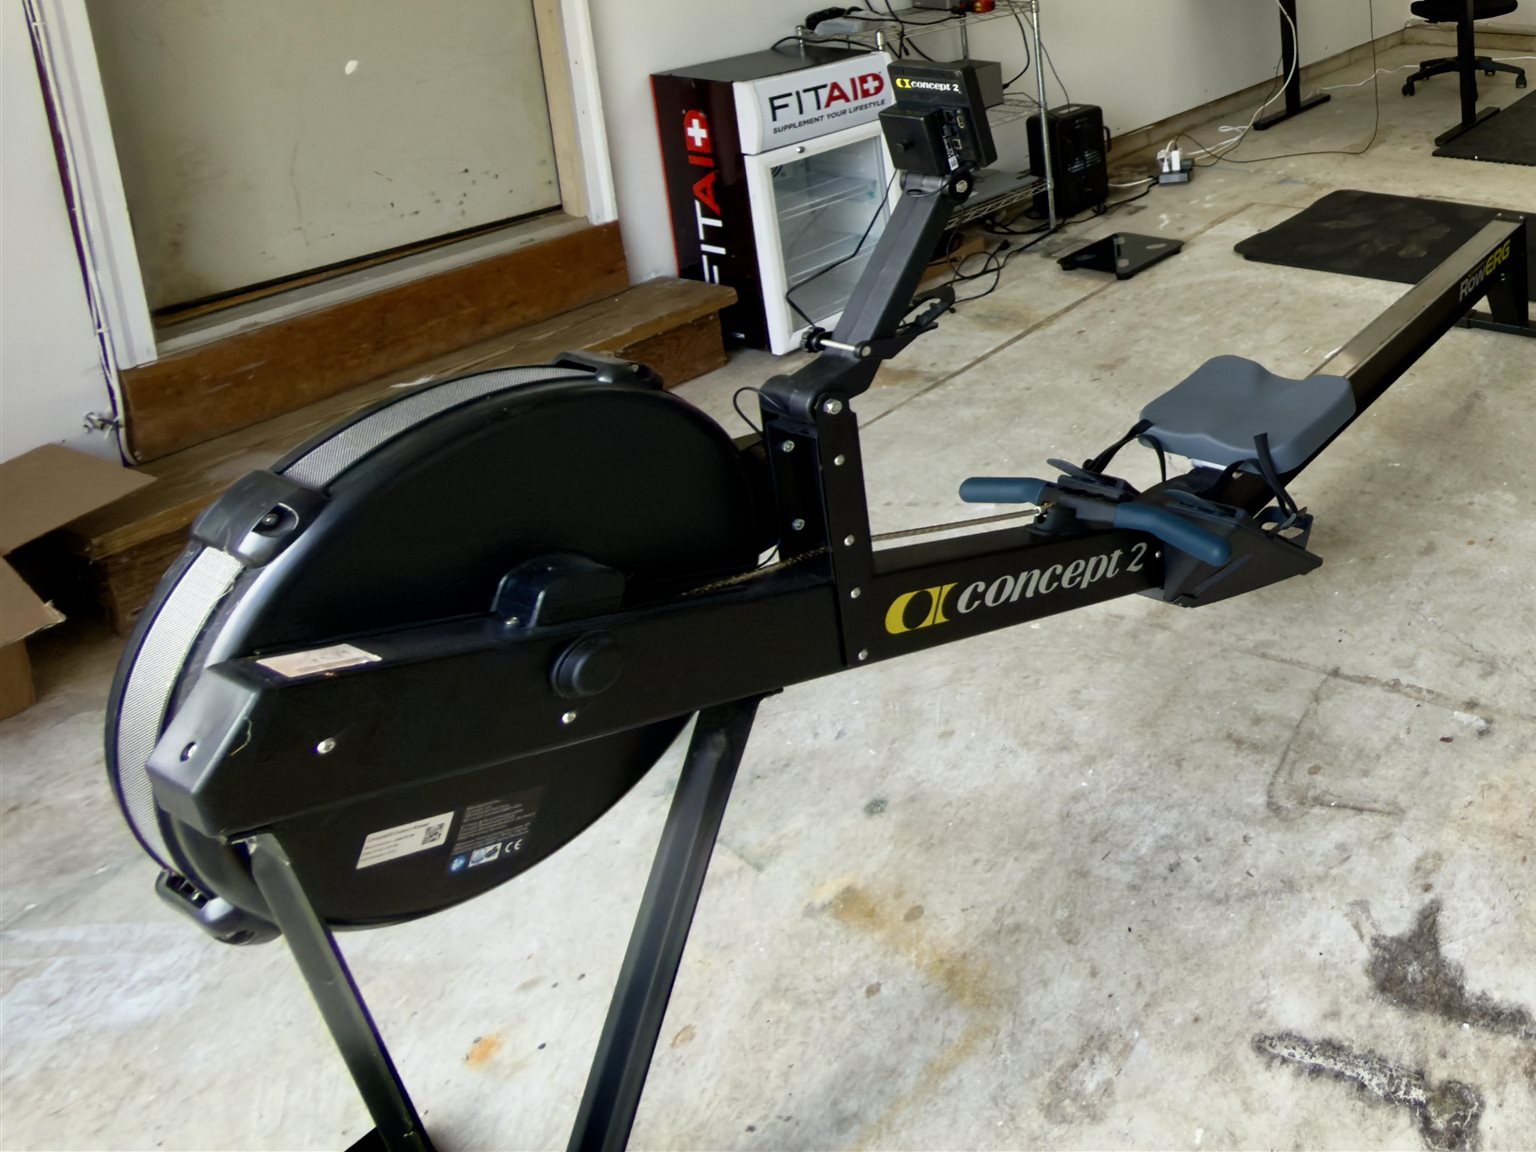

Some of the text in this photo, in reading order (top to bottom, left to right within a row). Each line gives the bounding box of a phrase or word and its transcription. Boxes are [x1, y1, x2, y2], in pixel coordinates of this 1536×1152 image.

[768, 72, 885, 122] FITAID
[911, 80, 960, 92] concept 2
[773, 98, 886, 135] SUPPLEMENT YOUR LIFESTYLE
[956, 542, 1148, 615] concept 2
